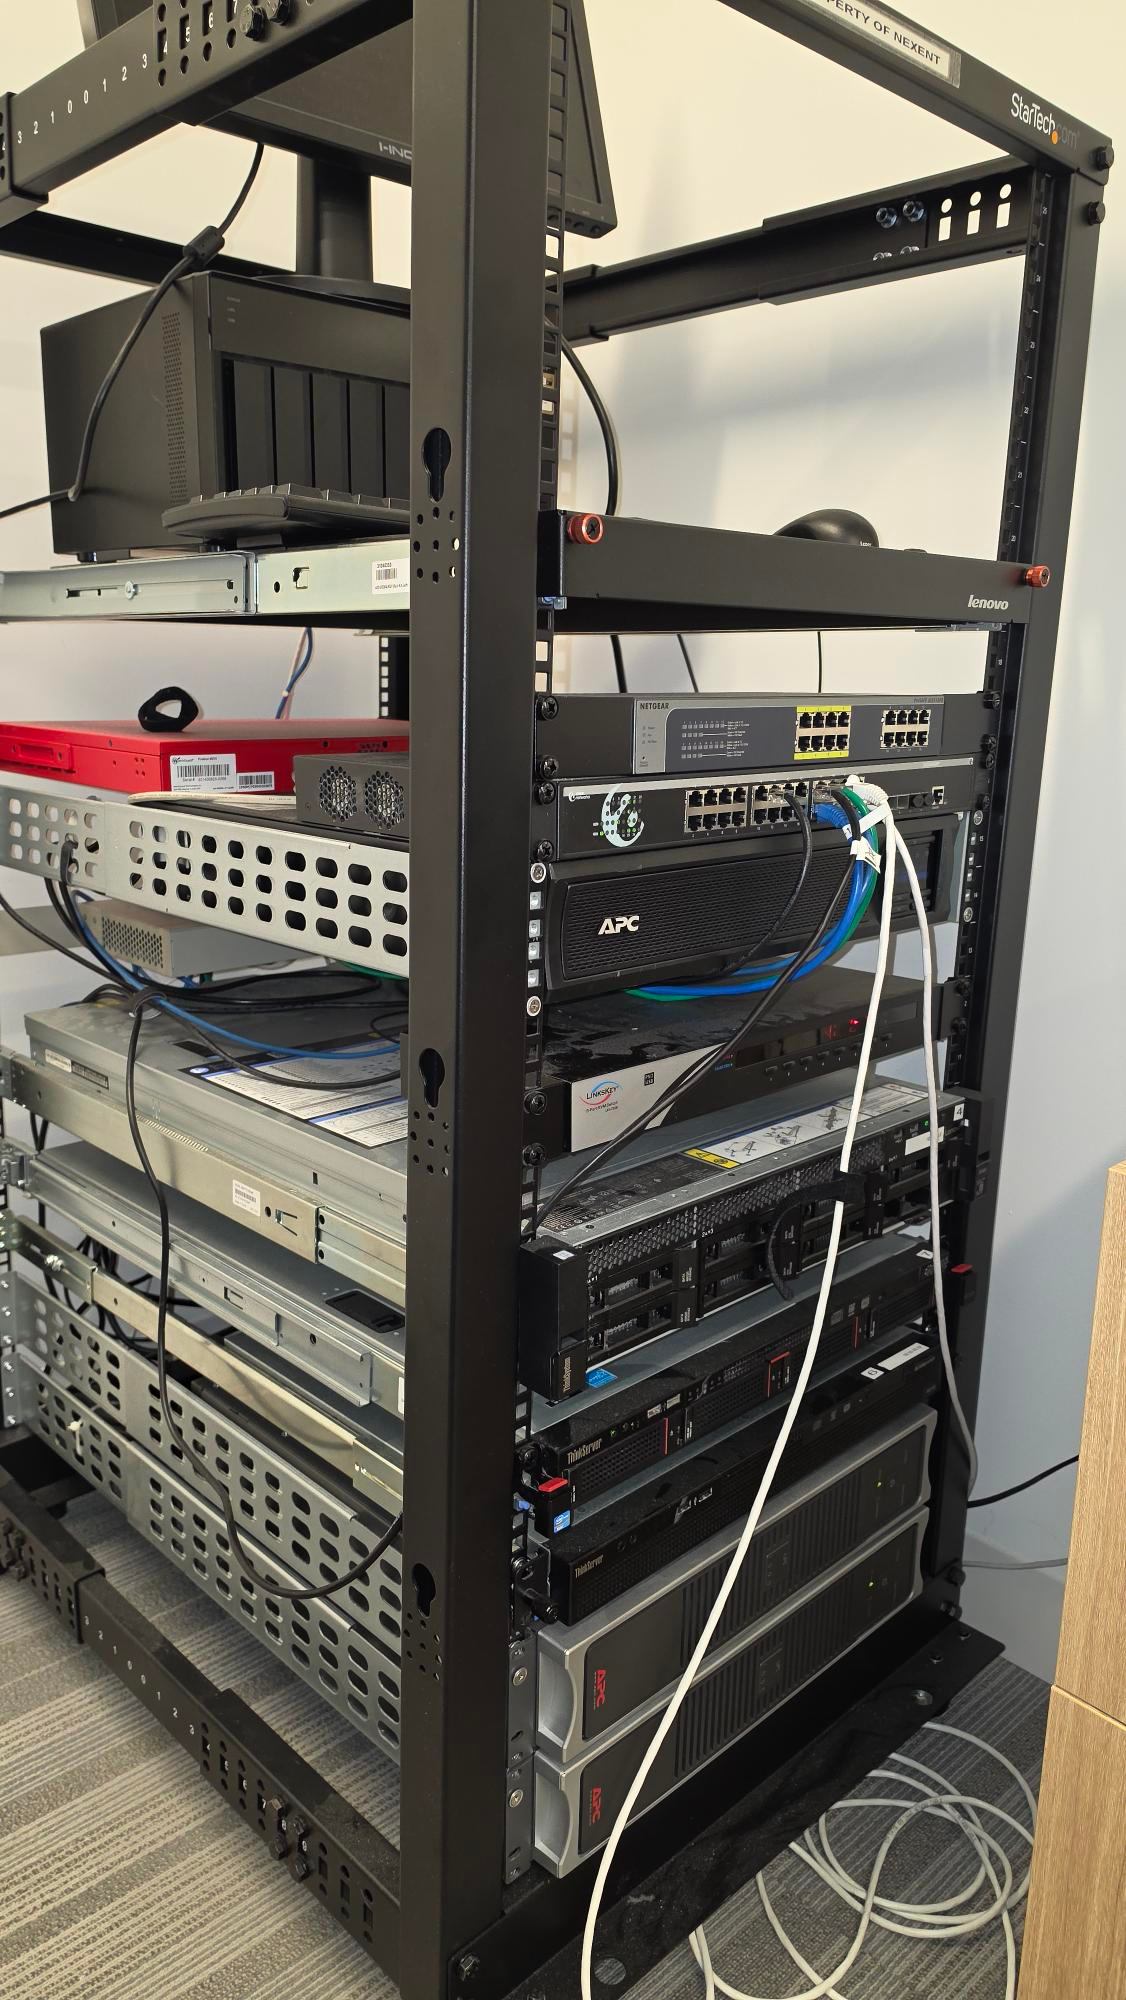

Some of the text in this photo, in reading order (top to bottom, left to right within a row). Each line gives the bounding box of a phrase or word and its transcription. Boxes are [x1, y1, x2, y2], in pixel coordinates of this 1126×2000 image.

[873, 21, 891, 35] OF
[893, 31, 941, 65] NEXENT
[17, 130, 23, 144] 3
[33, 120, 39, 135] 2
[50, 110, 55, 124] 1
[67, 99, 73, 114] 0
[83, 89, 89, 104] 0
[102, 78, 107, 93] 1
[121, 65, 128, 82] 2
[142, 53, 148, 69] 3
[967, 594, 1009, 610] lenovo
[640, 702, 669, 710] NETGEAR
[598, 914, 640, 935] APC
[567, 1438, 602, 1465] ThinkServer
[574, 1554, 604, 1579] ThinkServer
[596, 1669, 607, 1708] APC
[592, 1787, 602, 1824] APC
